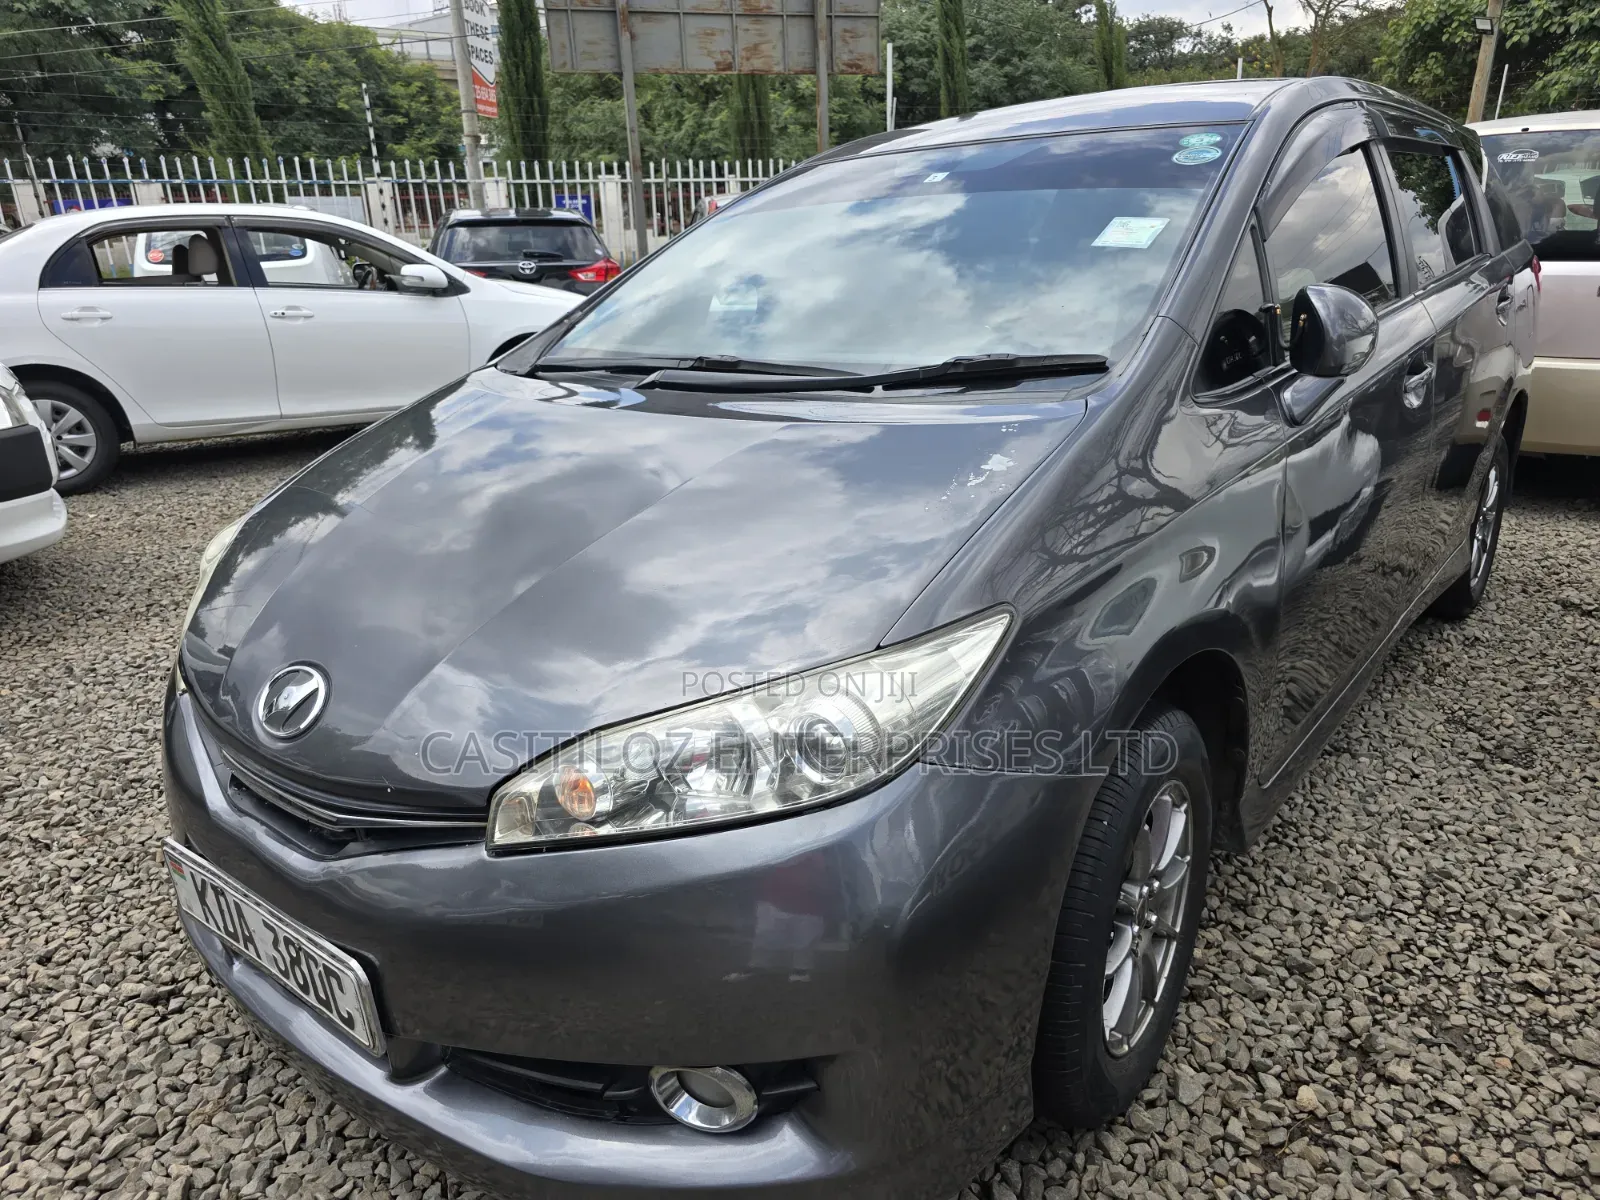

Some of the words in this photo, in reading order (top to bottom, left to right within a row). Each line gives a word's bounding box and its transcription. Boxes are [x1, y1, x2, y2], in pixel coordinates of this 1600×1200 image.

[464, 0, 486, 17] BOOK
[464, 19, 490, 41] THESE
[189, 871, 262, 961] KDA
[262, 917, 355, 1031] 380C
